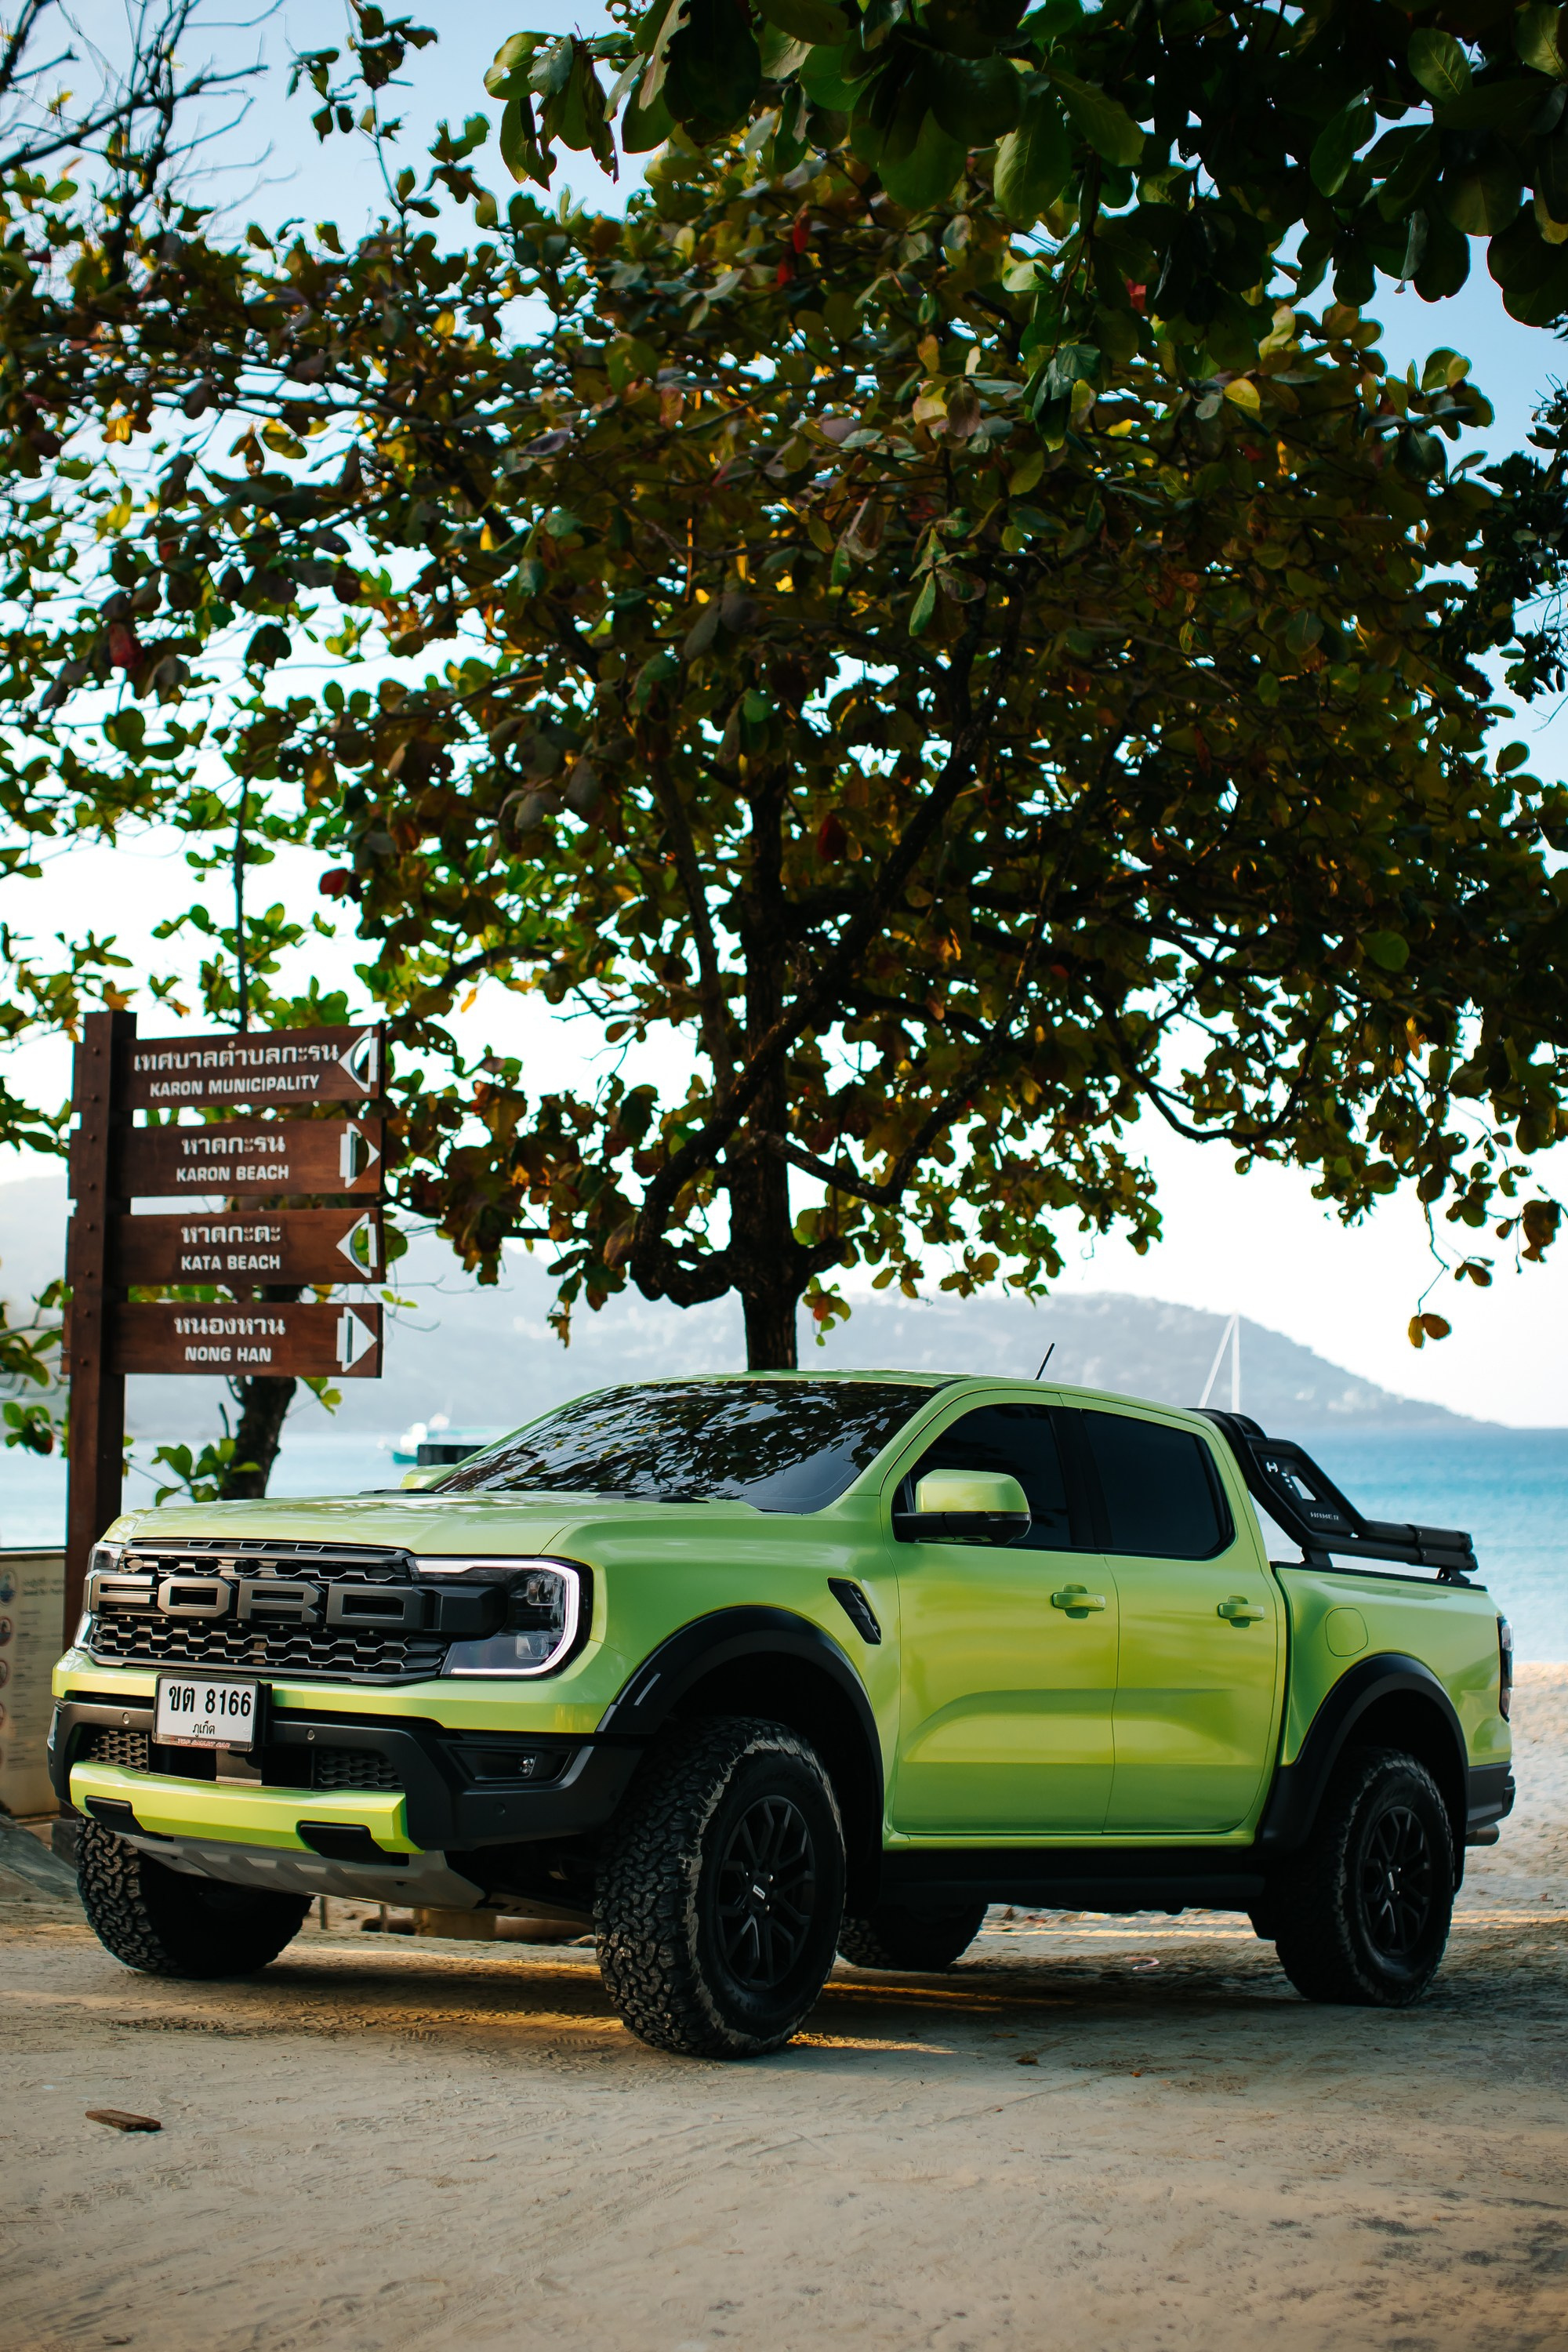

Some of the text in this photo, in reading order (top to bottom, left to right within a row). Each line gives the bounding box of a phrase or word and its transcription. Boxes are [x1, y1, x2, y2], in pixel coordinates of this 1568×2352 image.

[134, 1040, 339, 1071] เทศบาลตำบลกะรน
[150, 1074, 319, 1098] KARON MUNICIPALITY
[181, 1135, 286, 1155] หาดกะรน
[176, 1164, 289, 1182] KARON BEACH
[181, 1225, 281, 1243] หาดกะตะ
[181, 1254, 281, 1270] KATA BEACH
[174, 1317, 286, 1335] หนองหาน
[185, 1346, 271, 1363] NONG HAN
[85, 1570, 425, 1629] FORD
[169, 1686, 252, 1717] ขต 8166
[192, 1720, 216, 1737] ภูเก็ต
